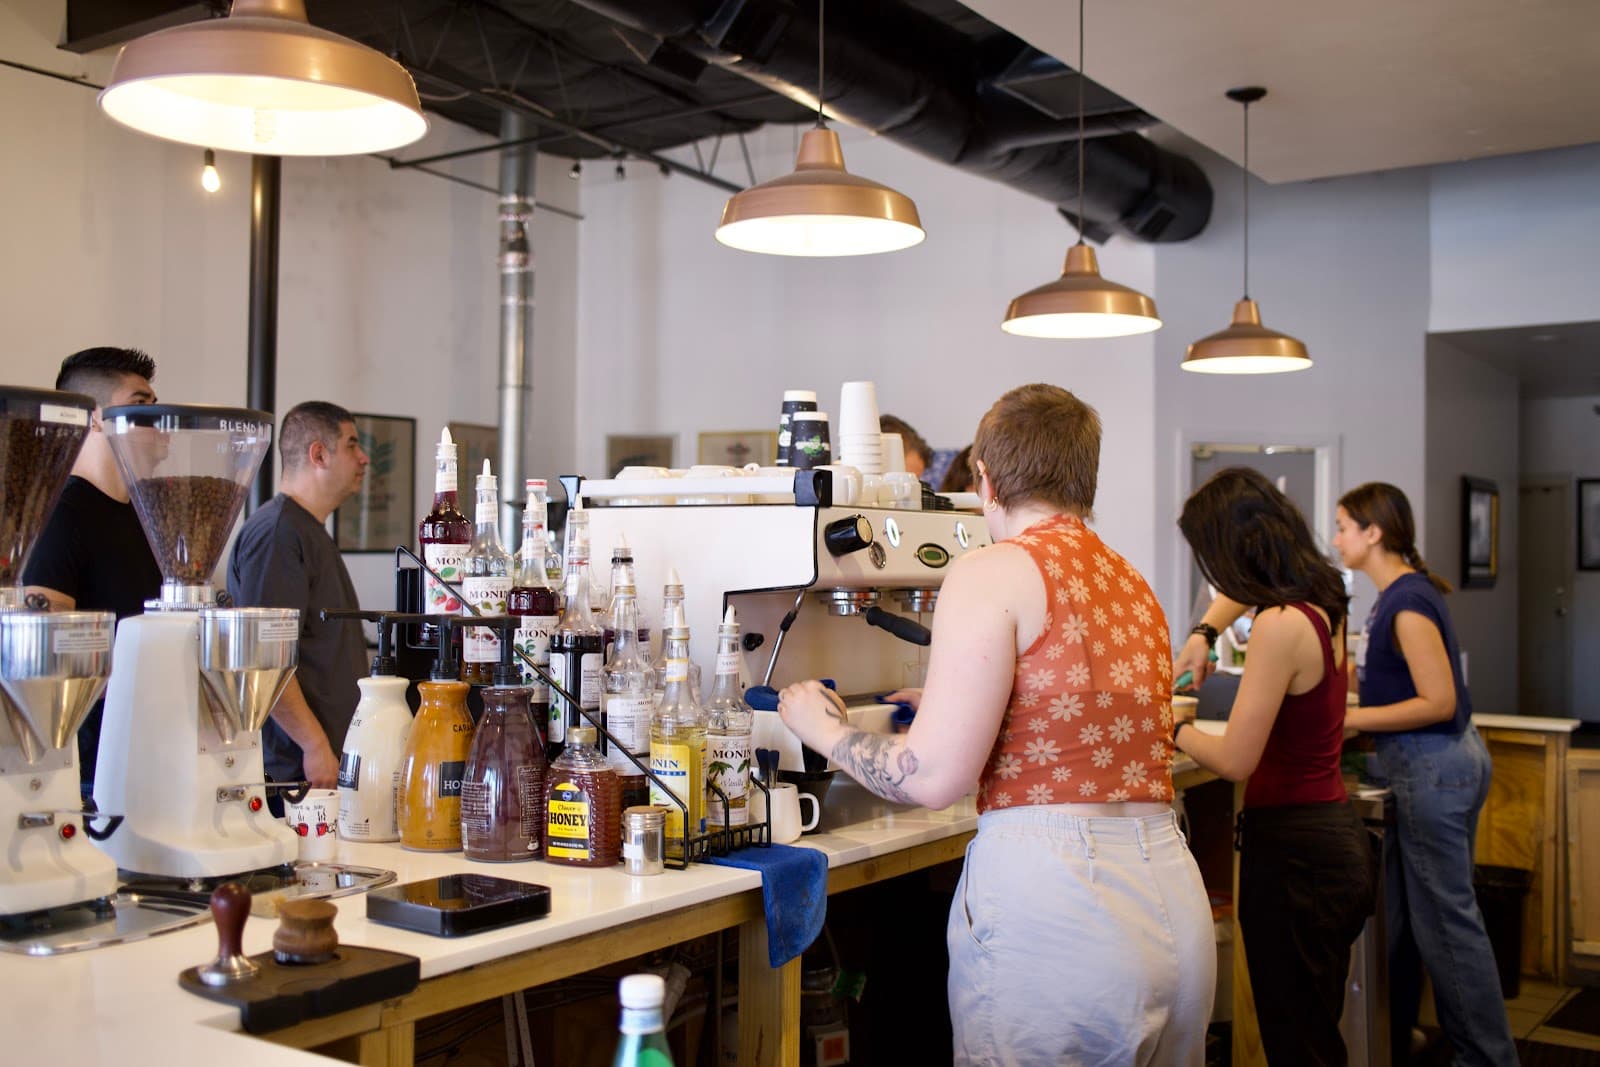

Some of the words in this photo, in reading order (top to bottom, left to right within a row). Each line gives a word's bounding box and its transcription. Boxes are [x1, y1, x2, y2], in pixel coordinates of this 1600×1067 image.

[219, 419, 256, 433] BLEND
[435, 557, 461, 566] MON
[518, 629, 548, 638] MON
[651, 758, 679, 769] ONIN
[549, 812, 587, 827] HONEY
